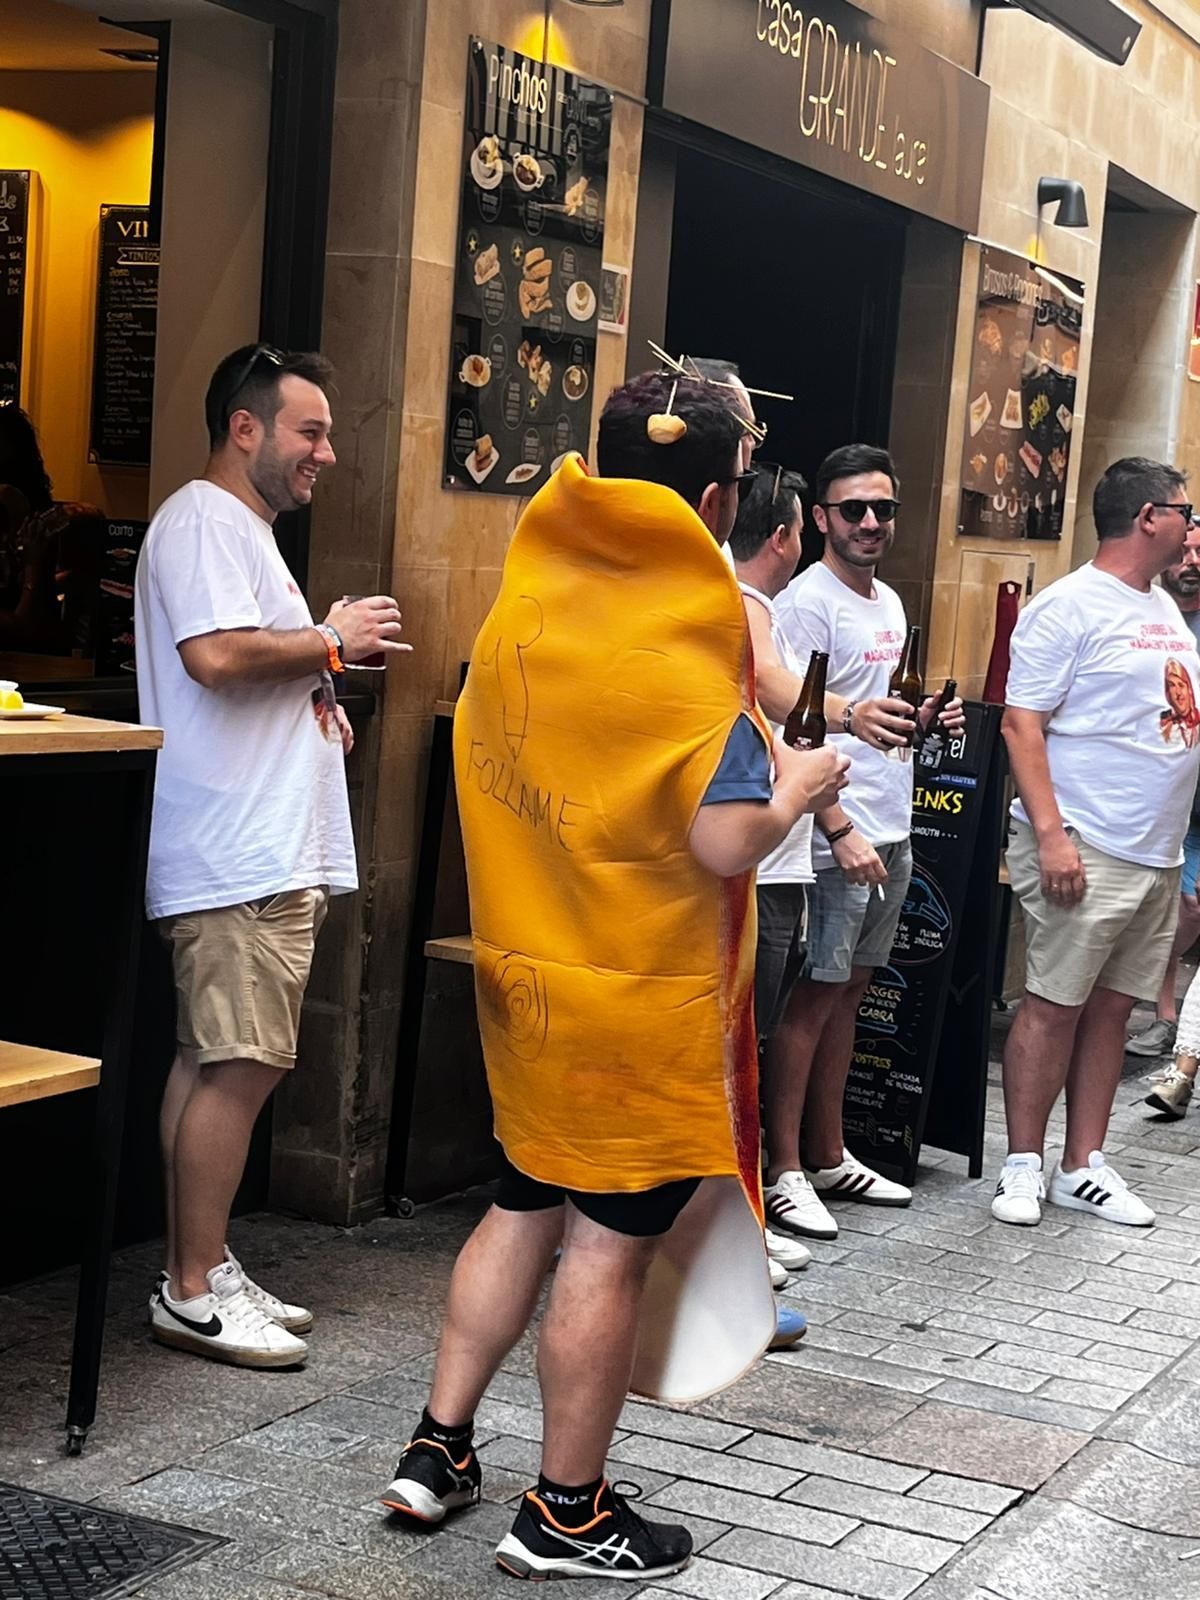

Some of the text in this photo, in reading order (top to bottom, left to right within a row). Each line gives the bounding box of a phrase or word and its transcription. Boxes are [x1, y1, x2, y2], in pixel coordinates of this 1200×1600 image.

[488, 54, 548, 114] Pinchos
[800, 17, 897, 170] GRANDE
[466, 738, 593, 853] FOLLAME
[912, 787, 964, 814] INKS
[858, 1006, 895, 1023] CABRA
[866, 984, 902, 1002] URGER
